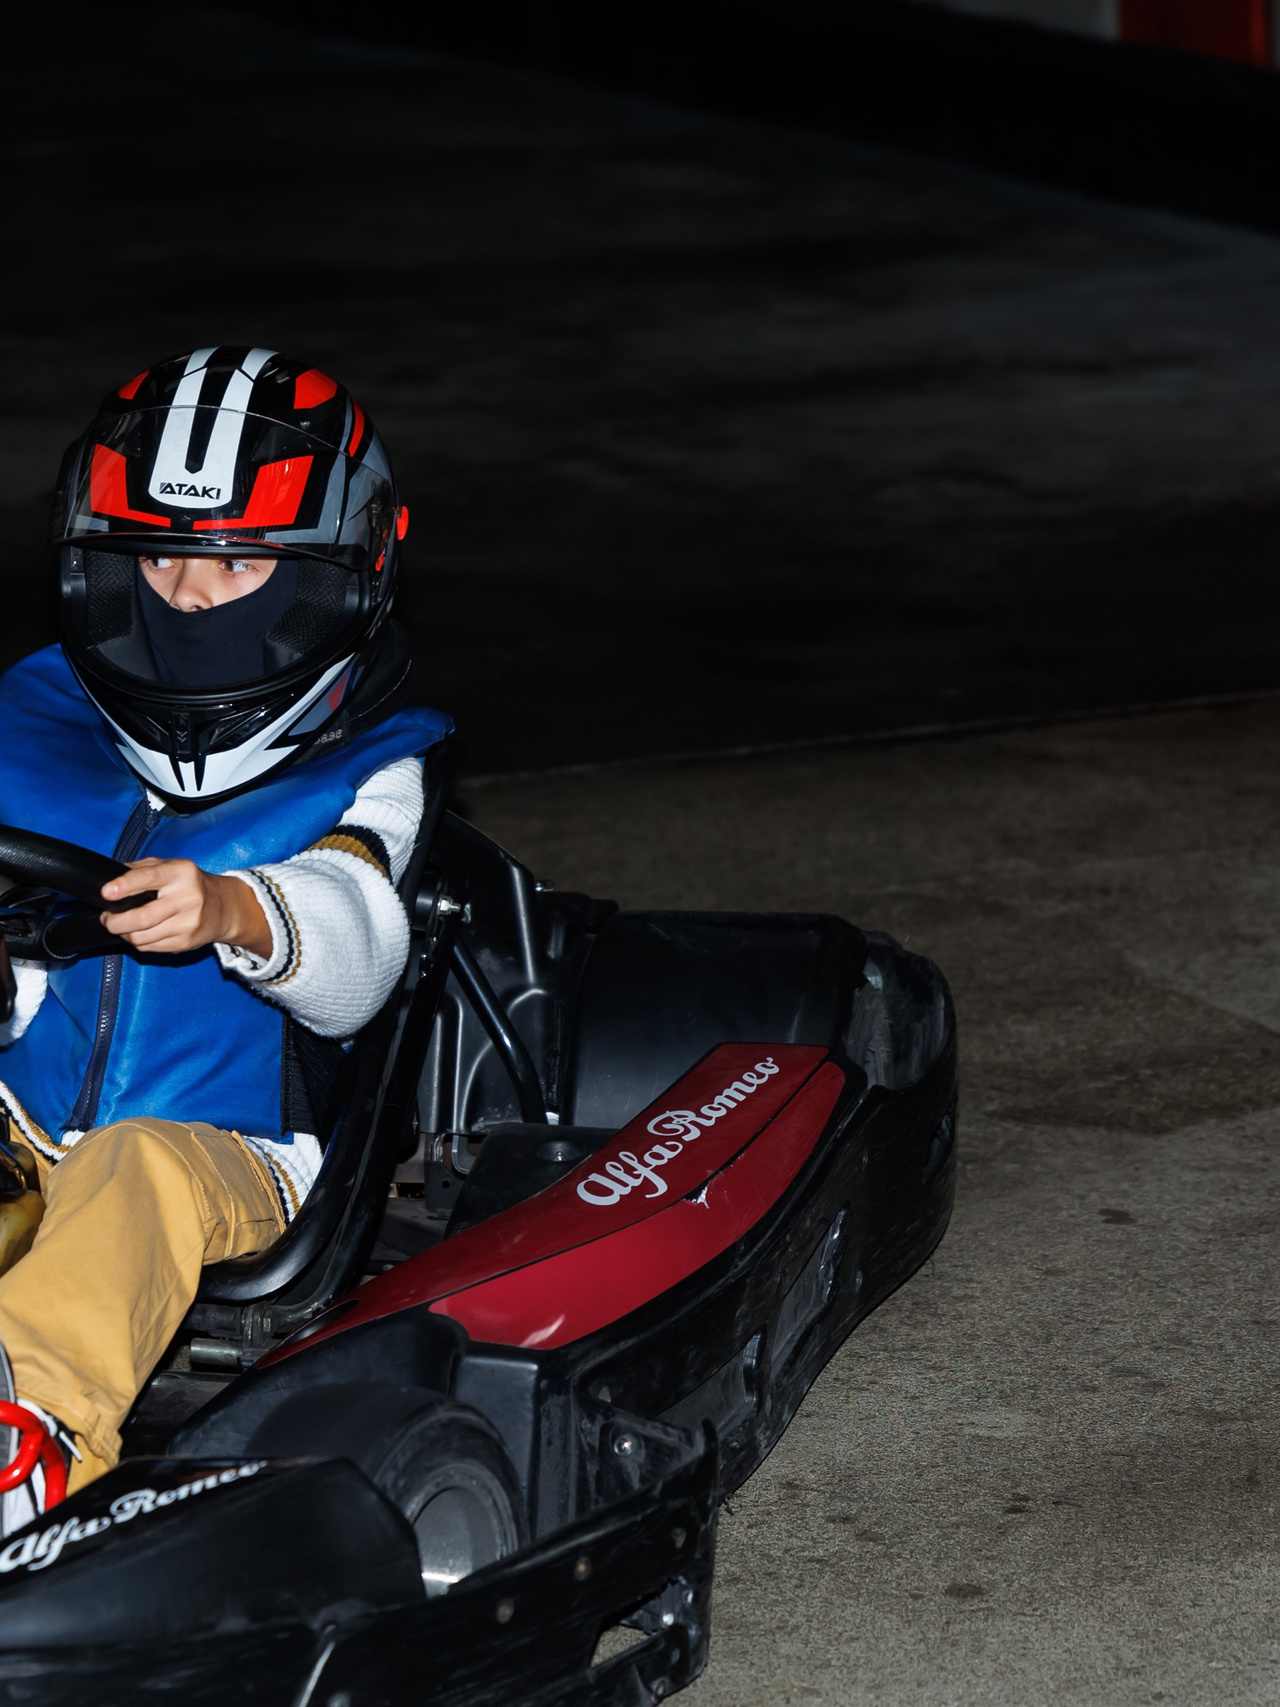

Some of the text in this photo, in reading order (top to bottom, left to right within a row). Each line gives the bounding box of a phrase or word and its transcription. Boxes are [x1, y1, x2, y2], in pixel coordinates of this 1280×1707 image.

[159, 482, 221, 500] ATAKI
[577, 1056, 780, 1206] Alfa Romeo
[109, 1460, 268, 1523] Romeo
